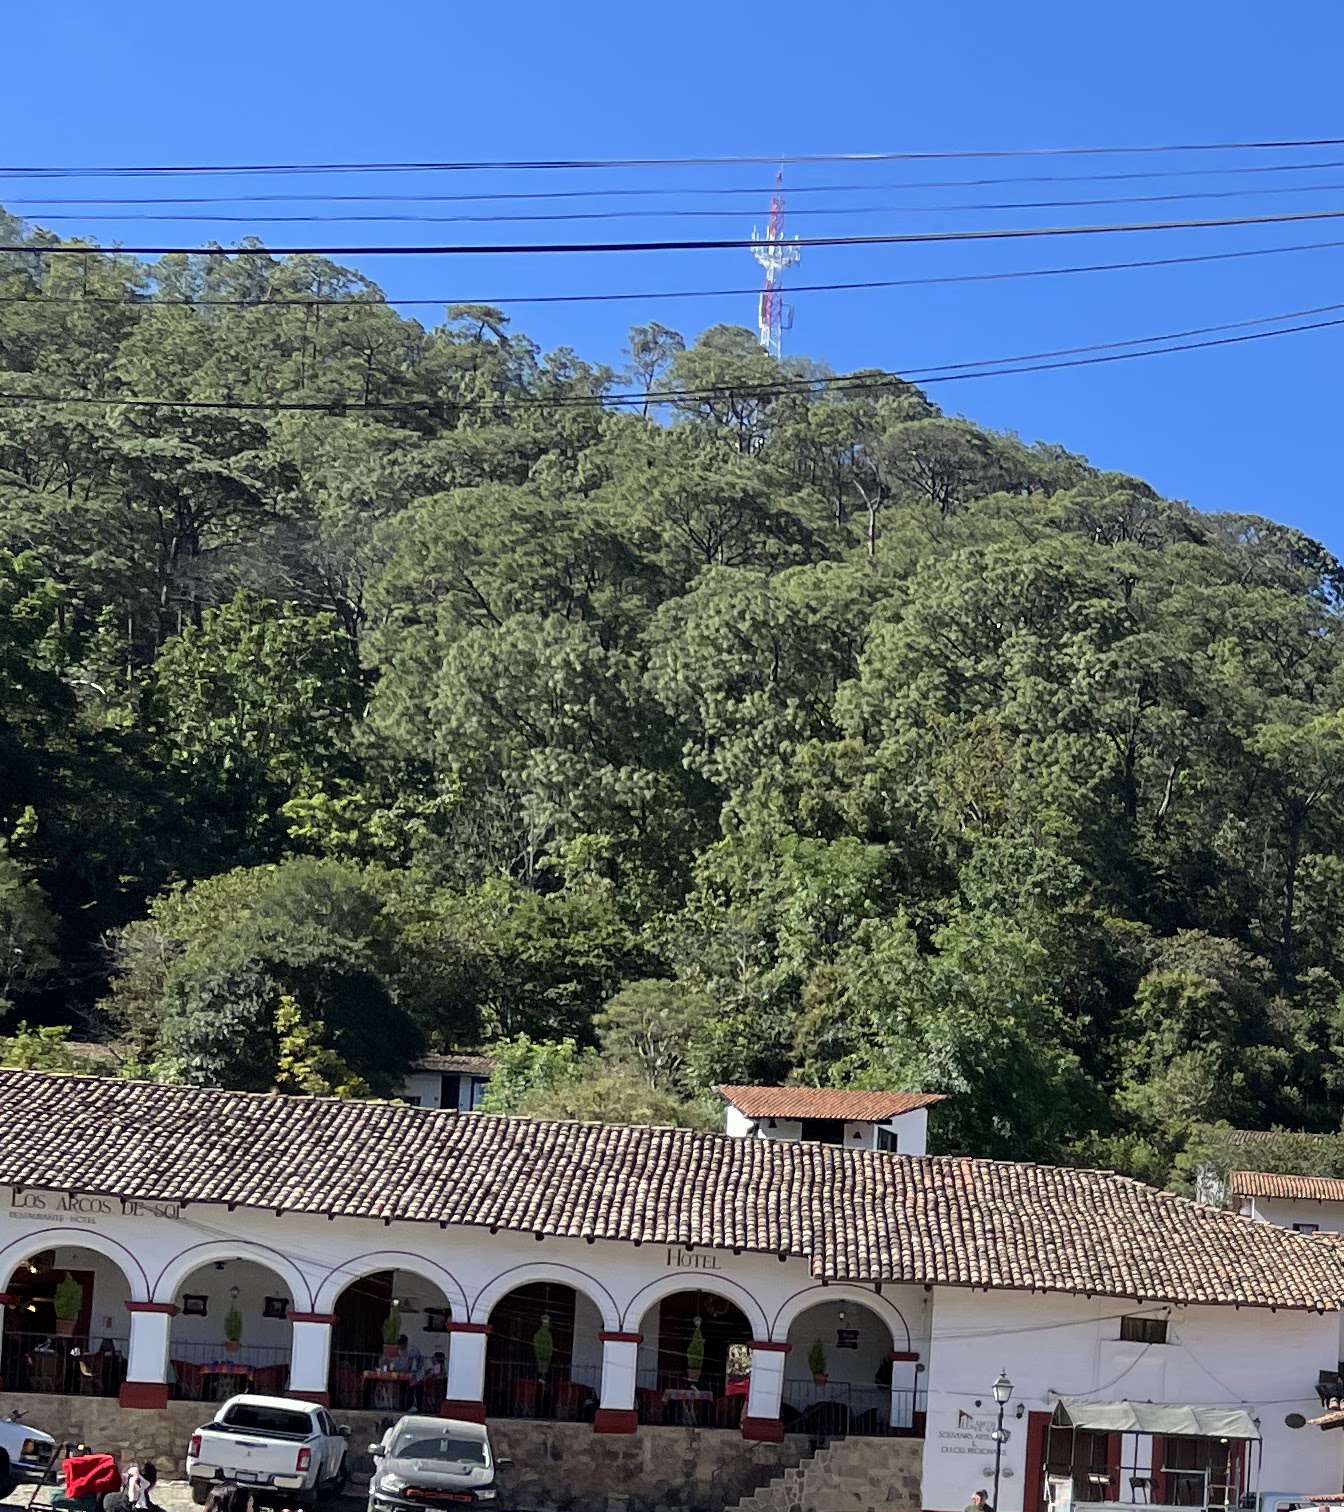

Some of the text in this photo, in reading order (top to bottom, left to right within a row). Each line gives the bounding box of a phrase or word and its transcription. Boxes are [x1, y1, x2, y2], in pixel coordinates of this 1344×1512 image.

[11, 1187, 46, 1208] LOS
[56, 1196, 112, 1214] ARCOS
[667, 1248, 722, 1270] HOTEL
[967, 1447, 1007, 1456] REGIONAES
